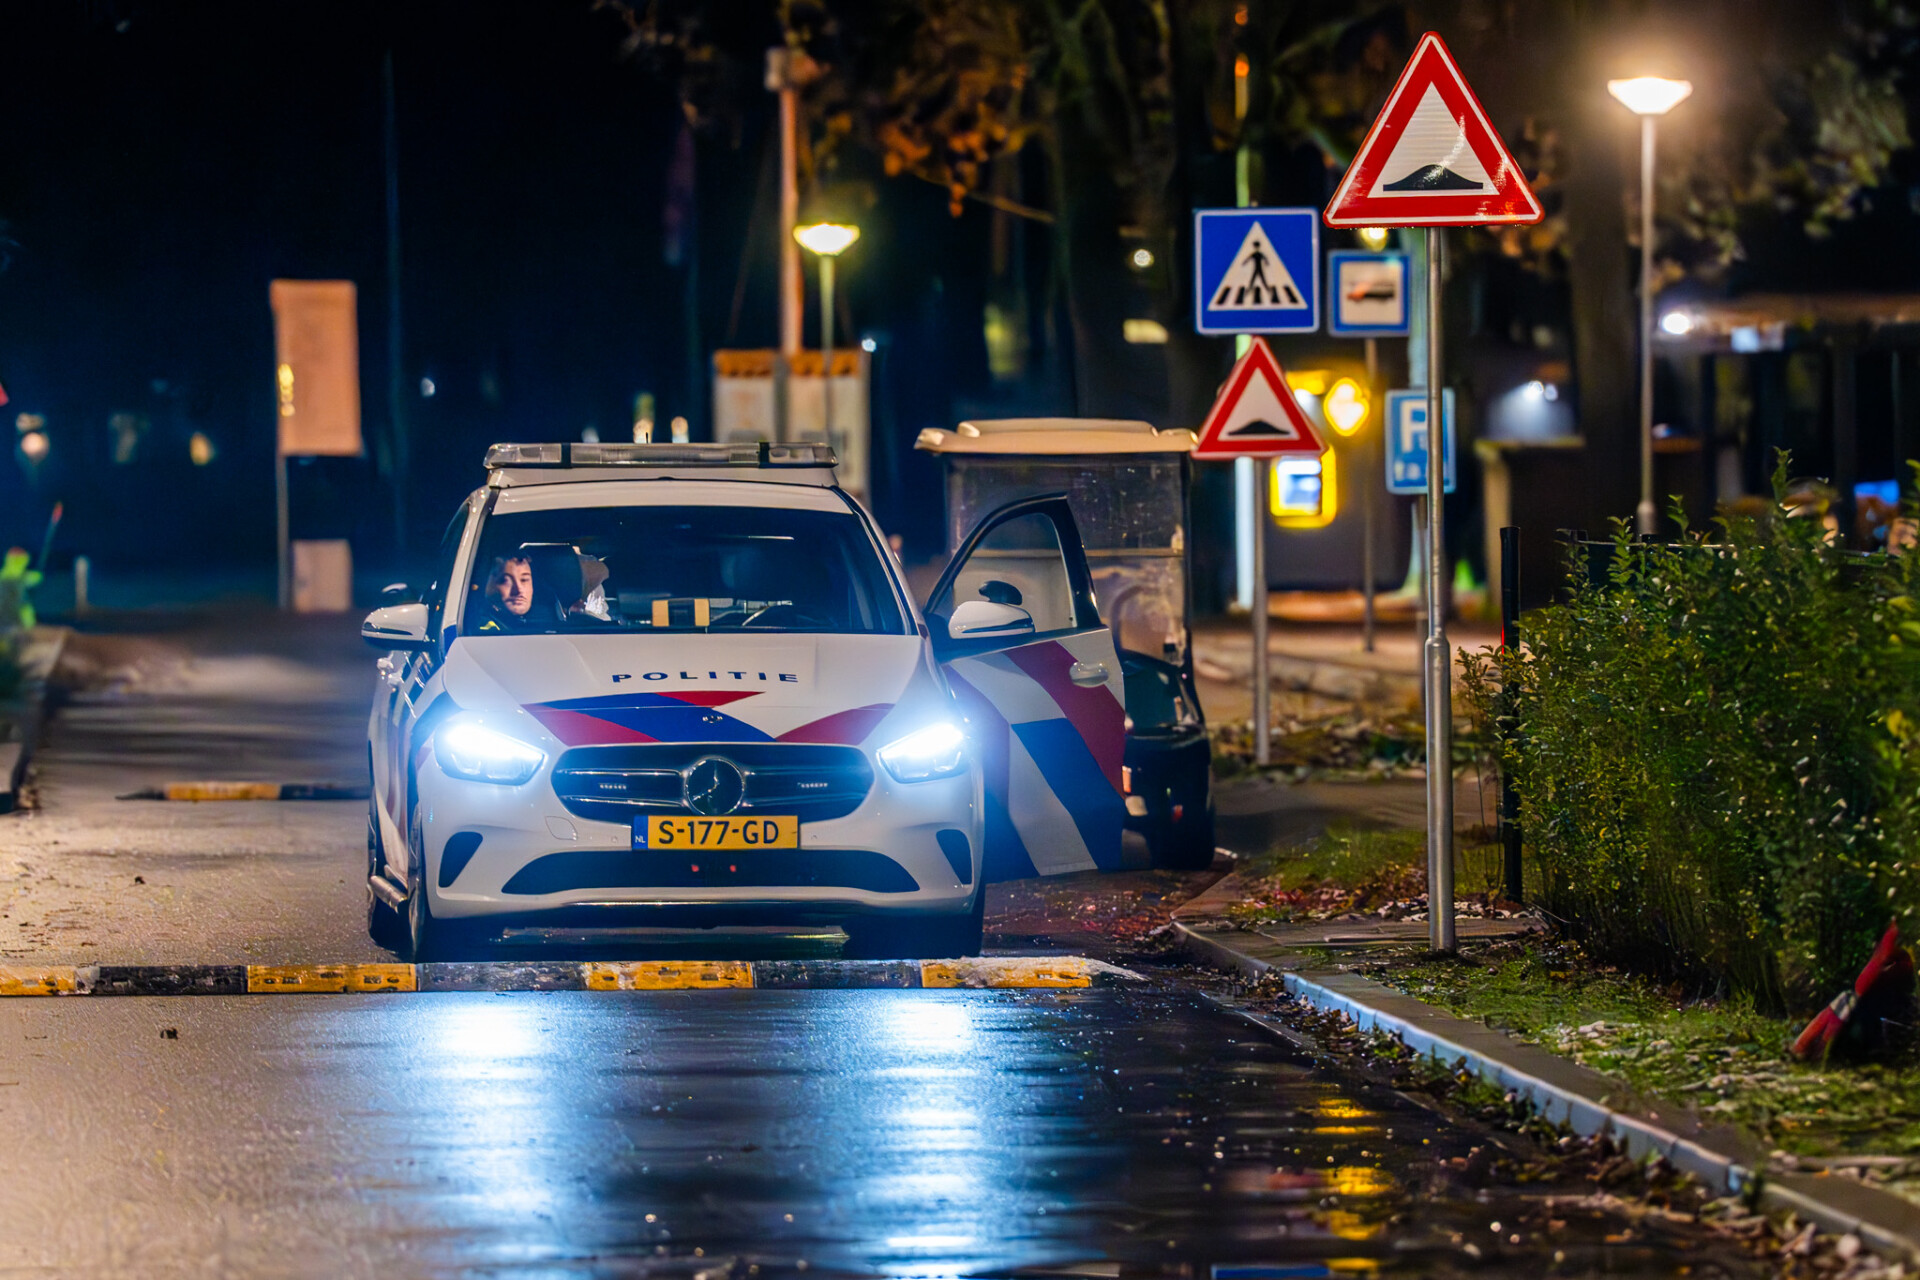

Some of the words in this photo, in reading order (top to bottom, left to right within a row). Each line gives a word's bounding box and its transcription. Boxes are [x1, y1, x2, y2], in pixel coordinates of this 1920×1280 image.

[611, 671, 799, 683] POLITIE
[658, 820, 779, 845] S-177-GD
[635, 835, 646, 843] NL
